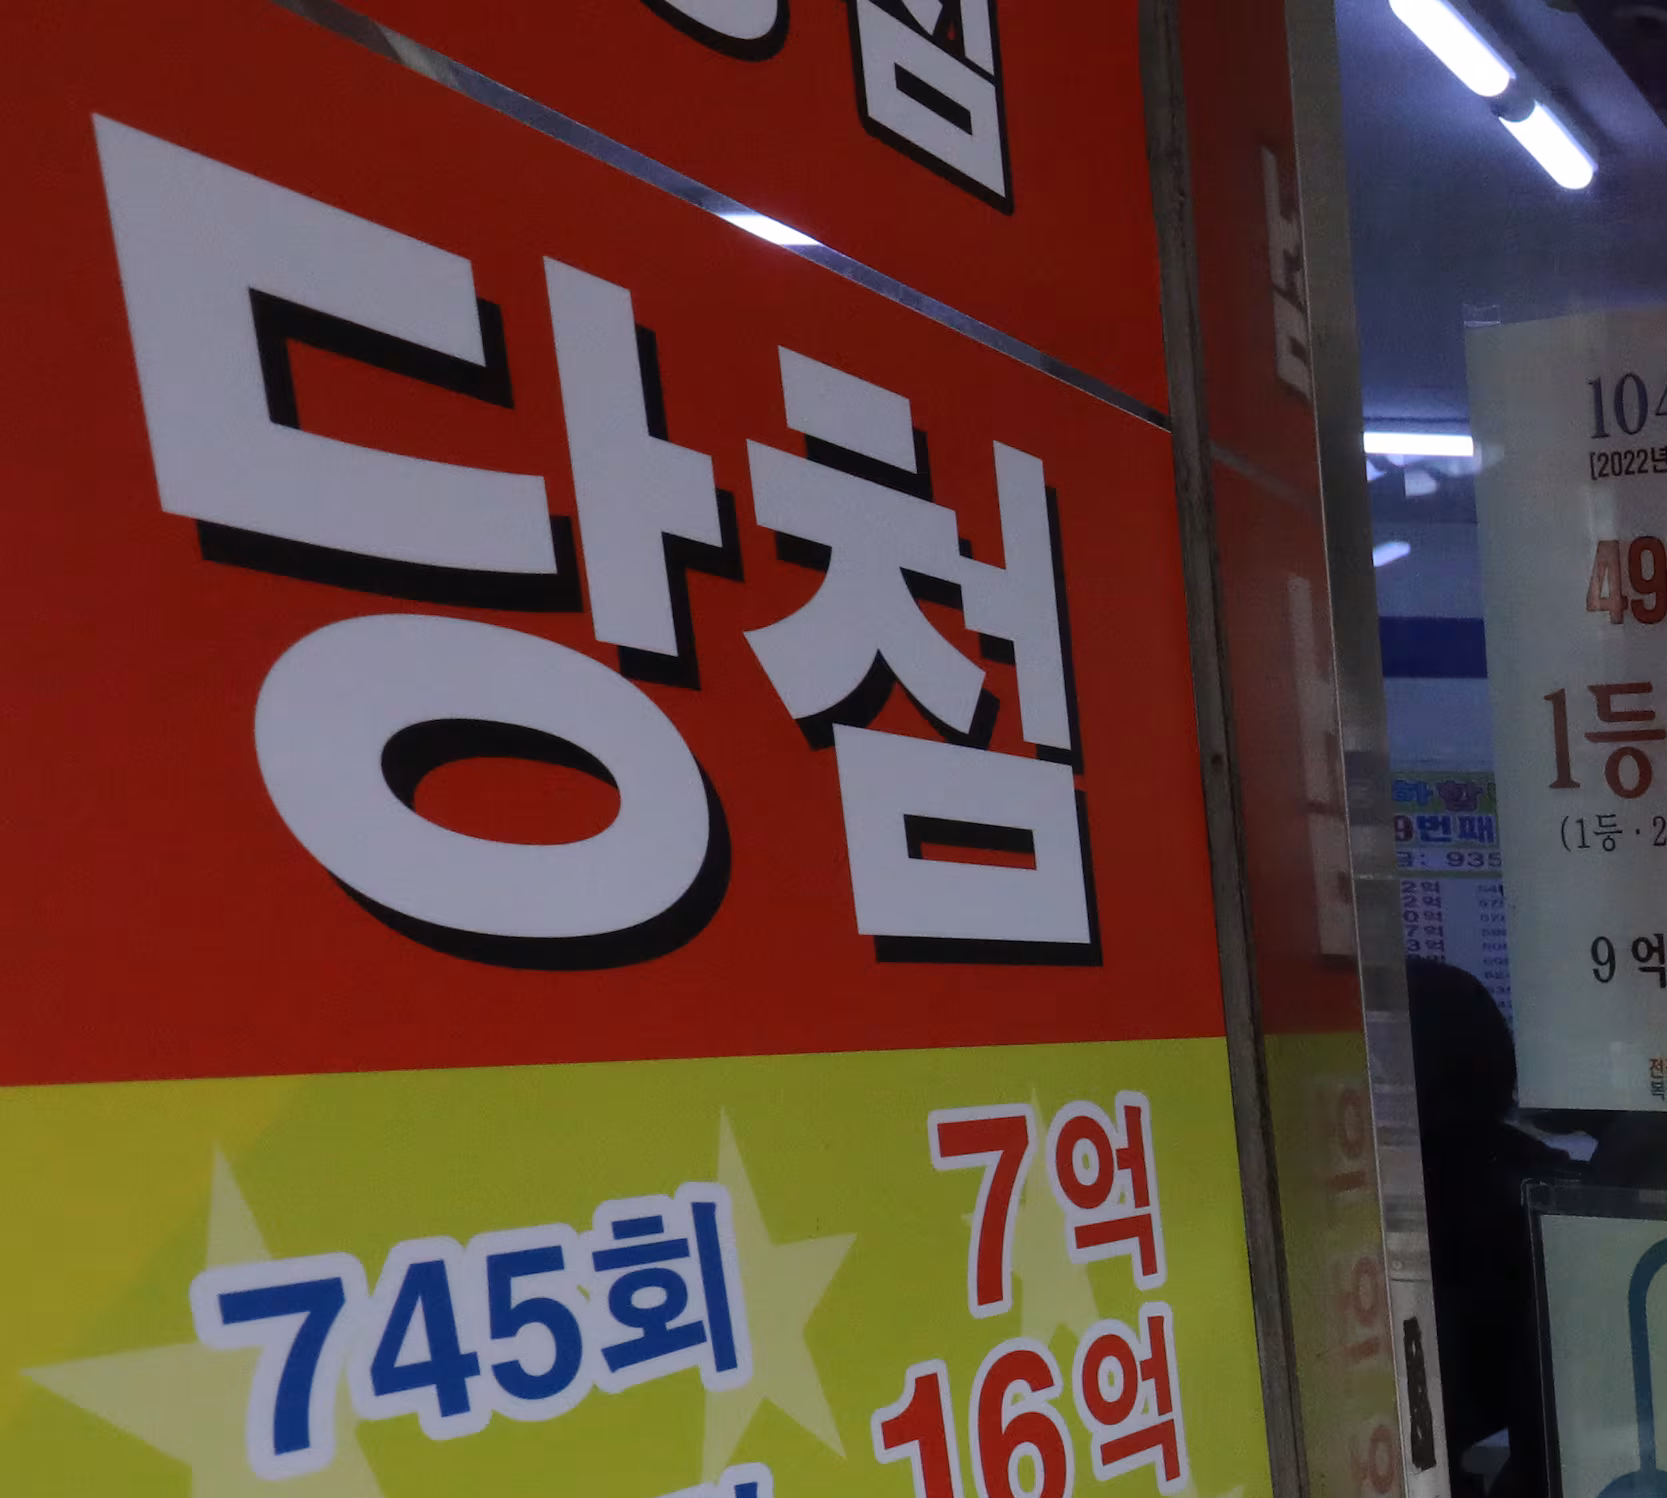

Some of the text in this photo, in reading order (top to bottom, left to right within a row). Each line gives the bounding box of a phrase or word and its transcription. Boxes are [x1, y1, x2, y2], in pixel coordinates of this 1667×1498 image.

[93, 113, 1100, 970] 당첨
[1543, 682, 1666, 799] 1등
[935, 1104, 1160, 1306] 7억
[219, 1201, 740, 1456] 745회
